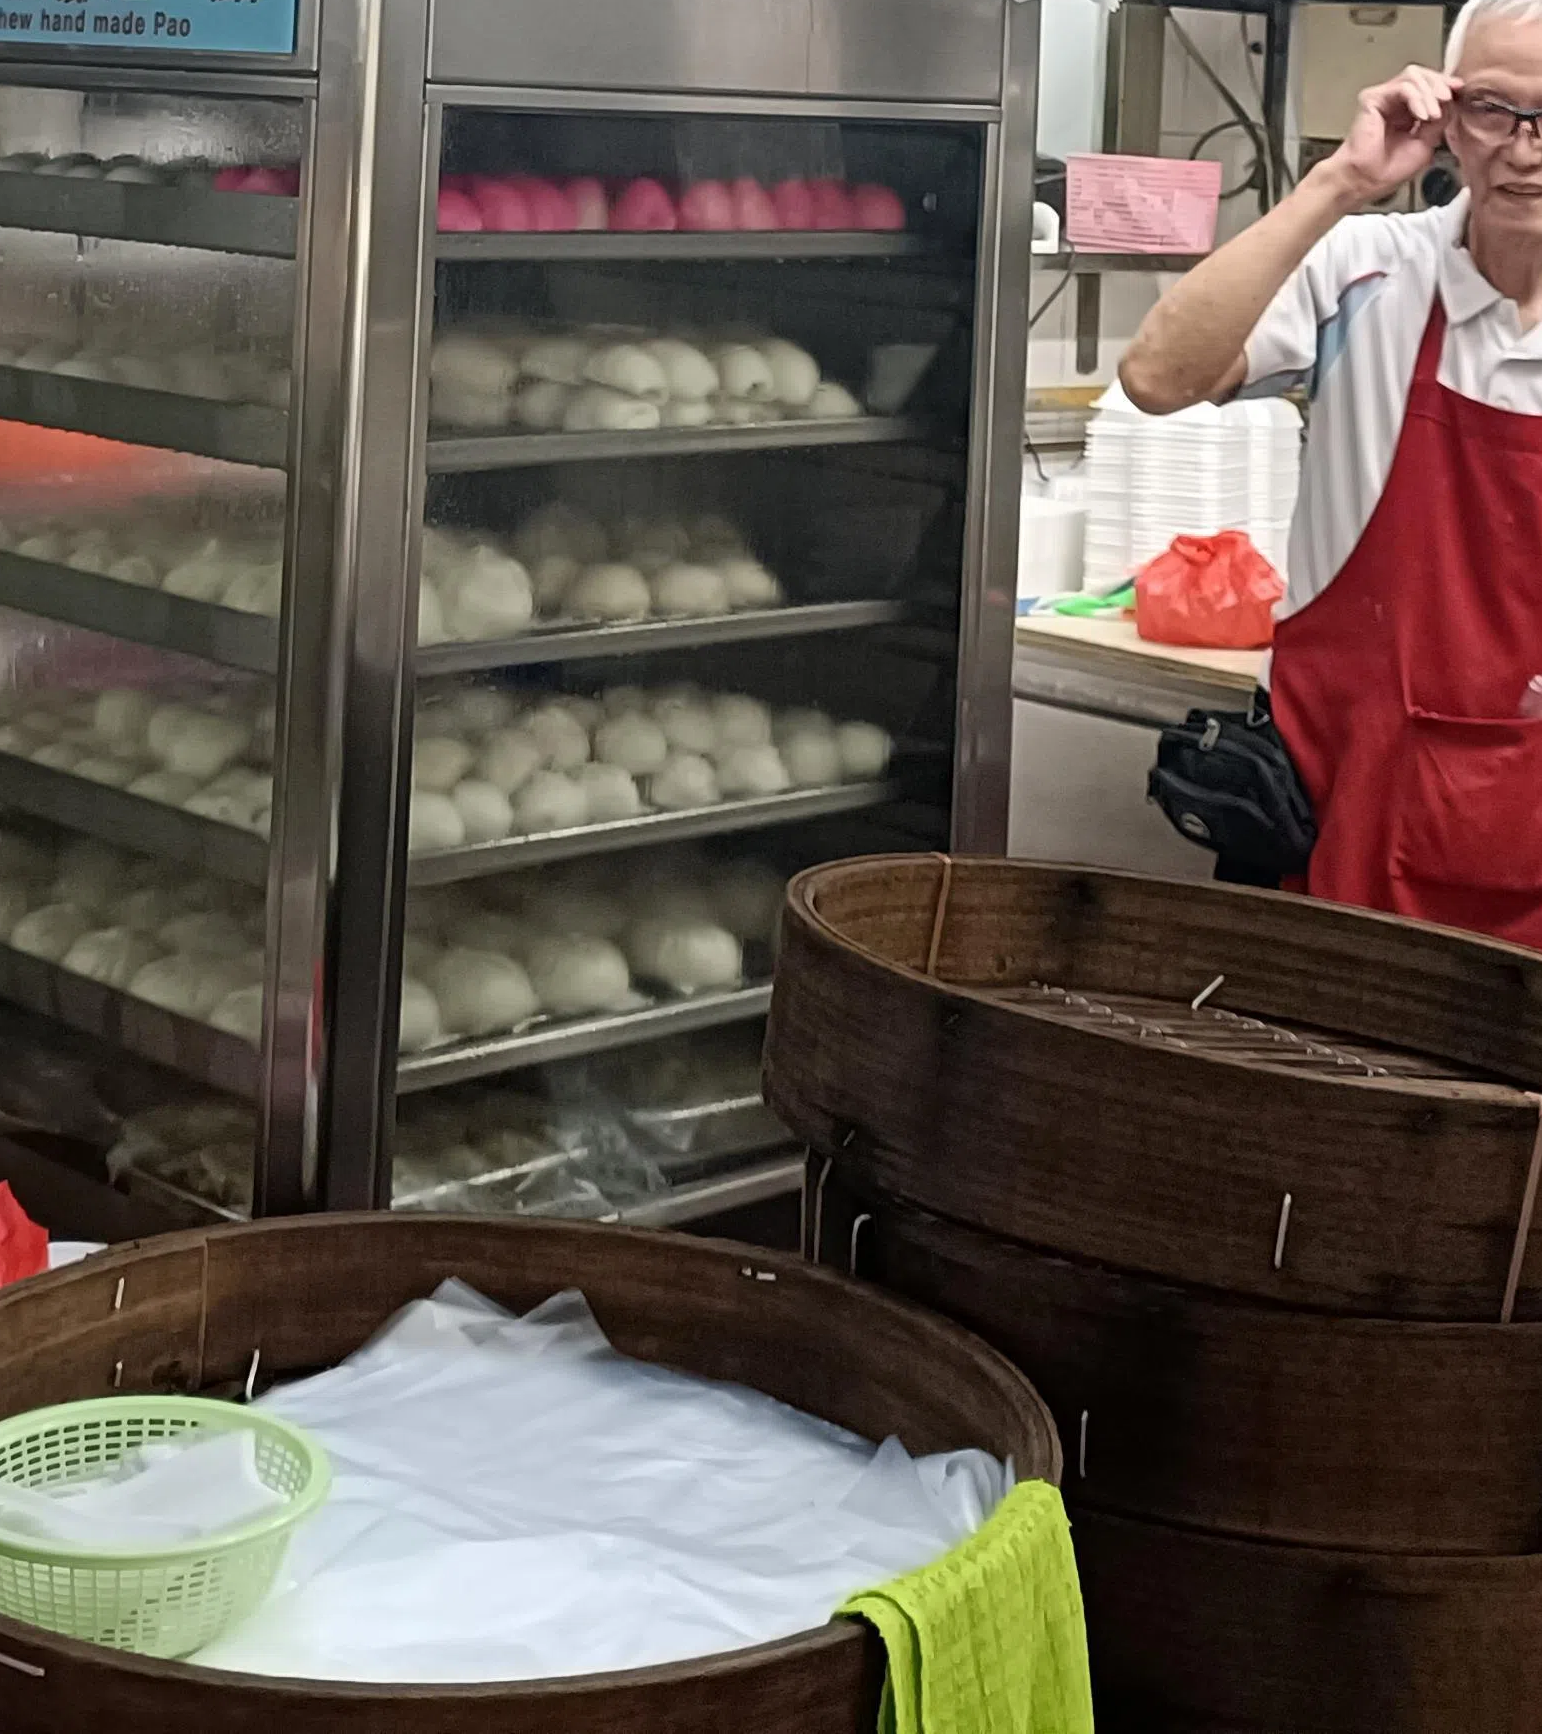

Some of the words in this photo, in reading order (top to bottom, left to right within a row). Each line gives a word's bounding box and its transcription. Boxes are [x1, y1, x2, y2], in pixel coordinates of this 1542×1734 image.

[40, 8, 86, 34] hand
[93, 11, 145, 35] made
[153, 12, 191, 37] Pao
